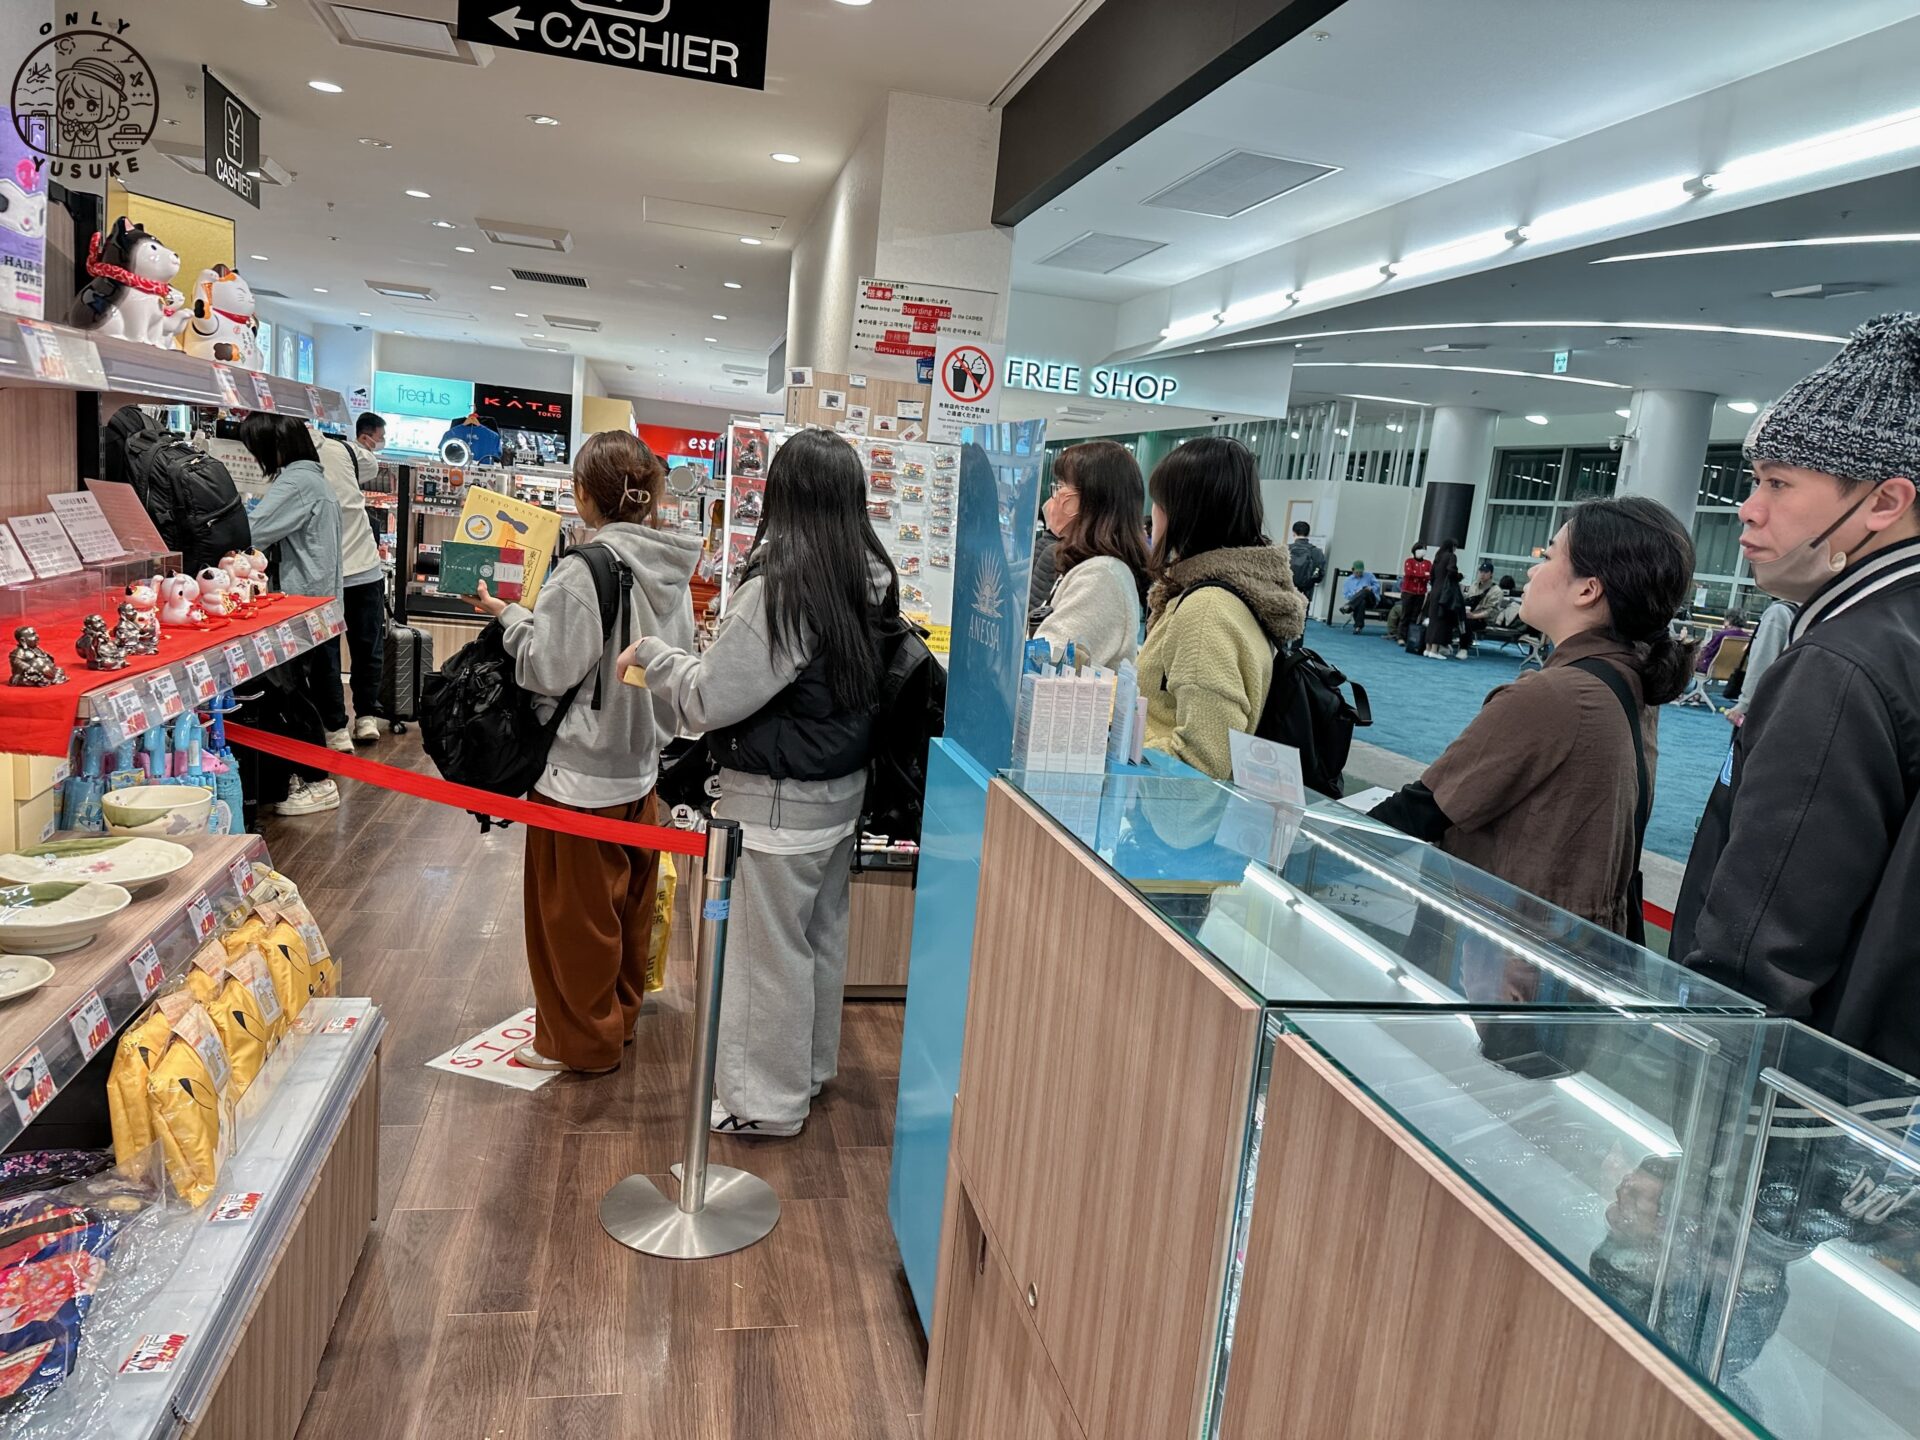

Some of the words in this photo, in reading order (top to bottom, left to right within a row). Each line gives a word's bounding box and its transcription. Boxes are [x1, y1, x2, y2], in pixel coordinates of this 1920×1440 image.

[540, 11, 740, 78] CASHIER
[215, 156, 252, 200] CASHIER
[903, 305, 933, 318] Boarding
[935, 308, 951, 319] Pass
[398, 385, 450, 406] freeplus
[1007, 360, 1080, 391] FREE
[1094, 370, 1177, 401] SHOP
[484, 397, 562, 413] KATE
[537, 411, 562, 419] TOKYO
[477, 494, 509, 509] TOKYO
[514, 504, 554, 524] BANANA
[968, 613, 1000, 652] ANESSA
